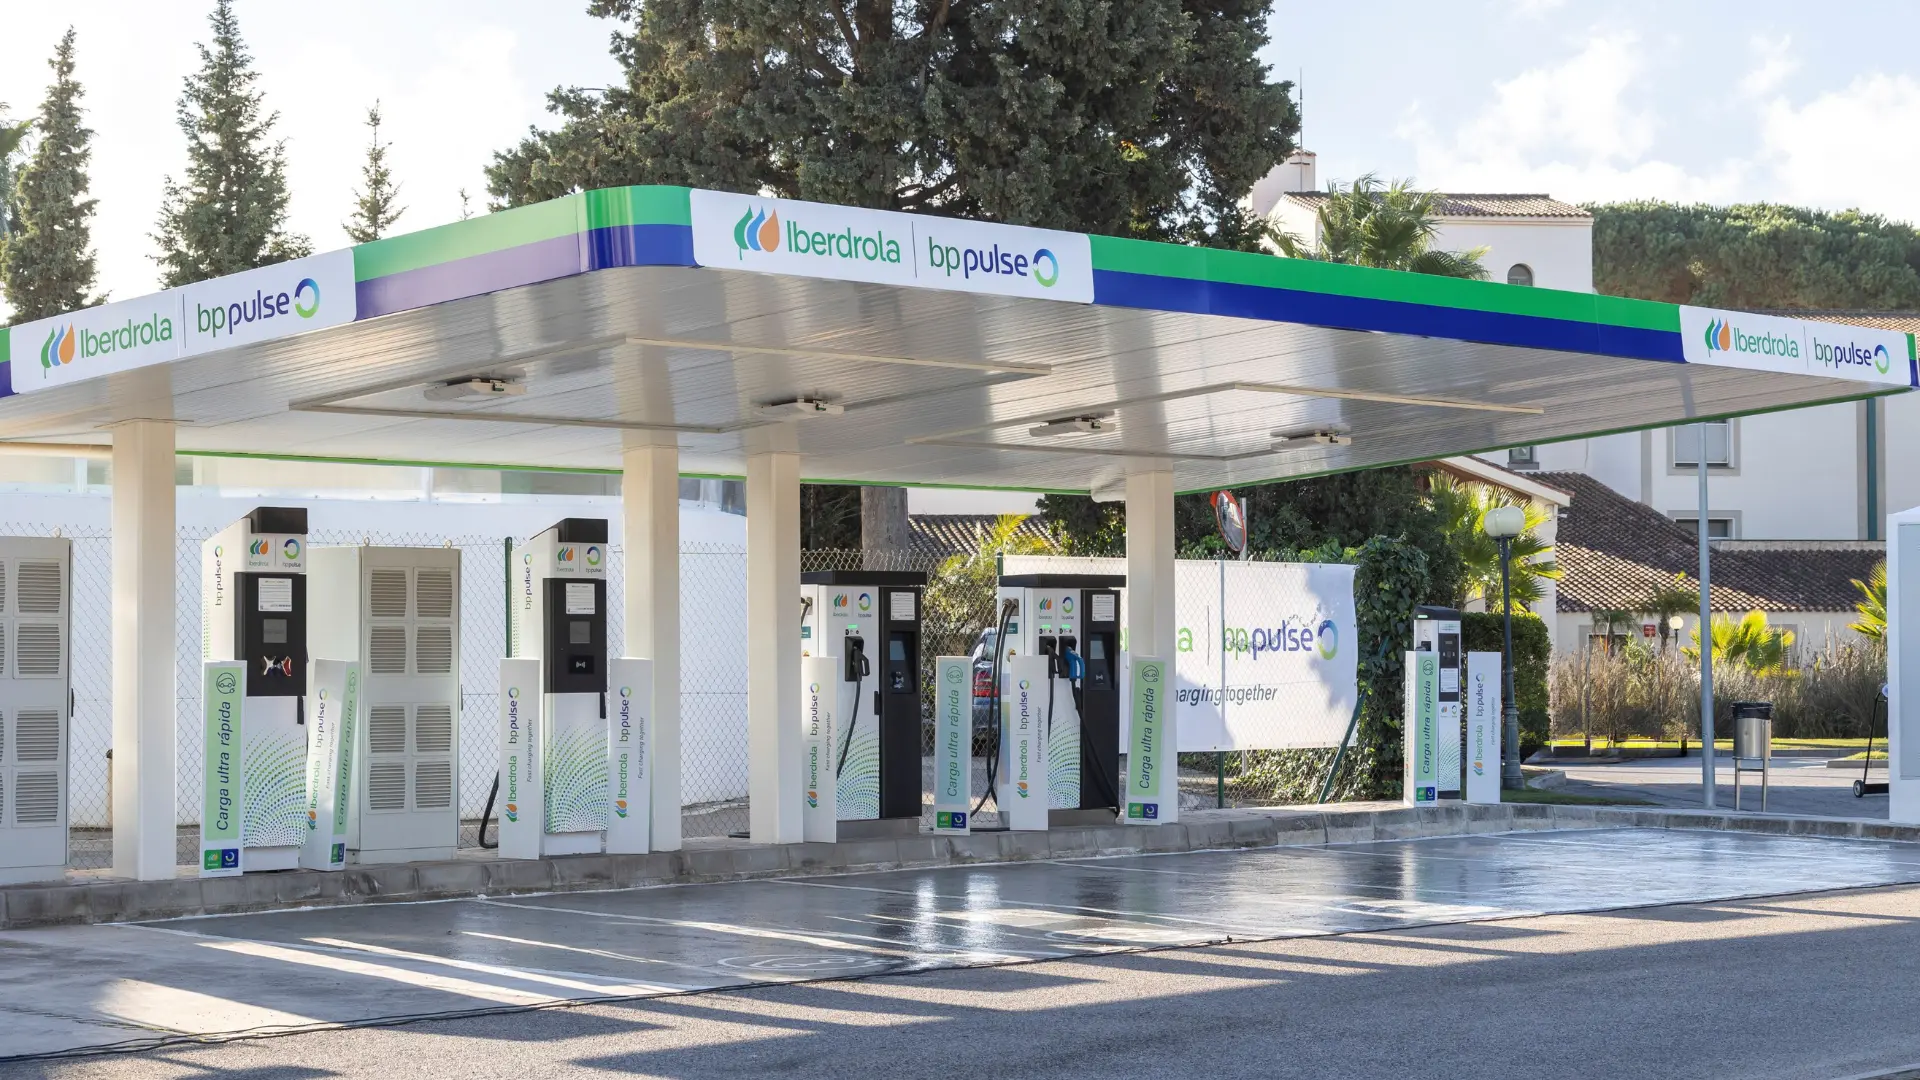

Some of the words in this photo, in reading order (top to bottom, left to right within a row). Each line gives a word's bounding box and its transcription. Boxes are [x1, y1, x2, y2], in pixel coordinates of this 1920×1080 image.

[786, 220, 900, 264] Iberdrola
[80, 313, 172, 358] Iberdrola
[1733, 327, 1799, 358] Iberdrola
[949, 690, 962, 727] rápida
[1142, 688, 1156, 724] rápida
[1176, 684, 1222, 706] arging
[1225, 684, 1278, 705] together
[1424, 680, 1432, 714] rápida
[218, 701, 233, 746] rápida
[1142, 728, 1152, 752] ultra
[1476, 724, 1484, 760] Iberdrola
[948, 731, 958, 756] ultra
[1019, 740, 1028, 780] Iberdrola
[1422, 742, 1432, 774] Carga
[217, 752, 229, 782] ultra
[338, 784, 346, 825] Carga
[344, 700, 353, 743] rápida
[508, 755, 518, 802] Iberdrola
[618, 753, 628, 799] Iberdrola
[947, 756, 960, 797] Carga
[1139, 752, 1153, 789] Carga
[310, 760, 321, 809] Iberdrola
[216, 782, 232, 830] Carga
